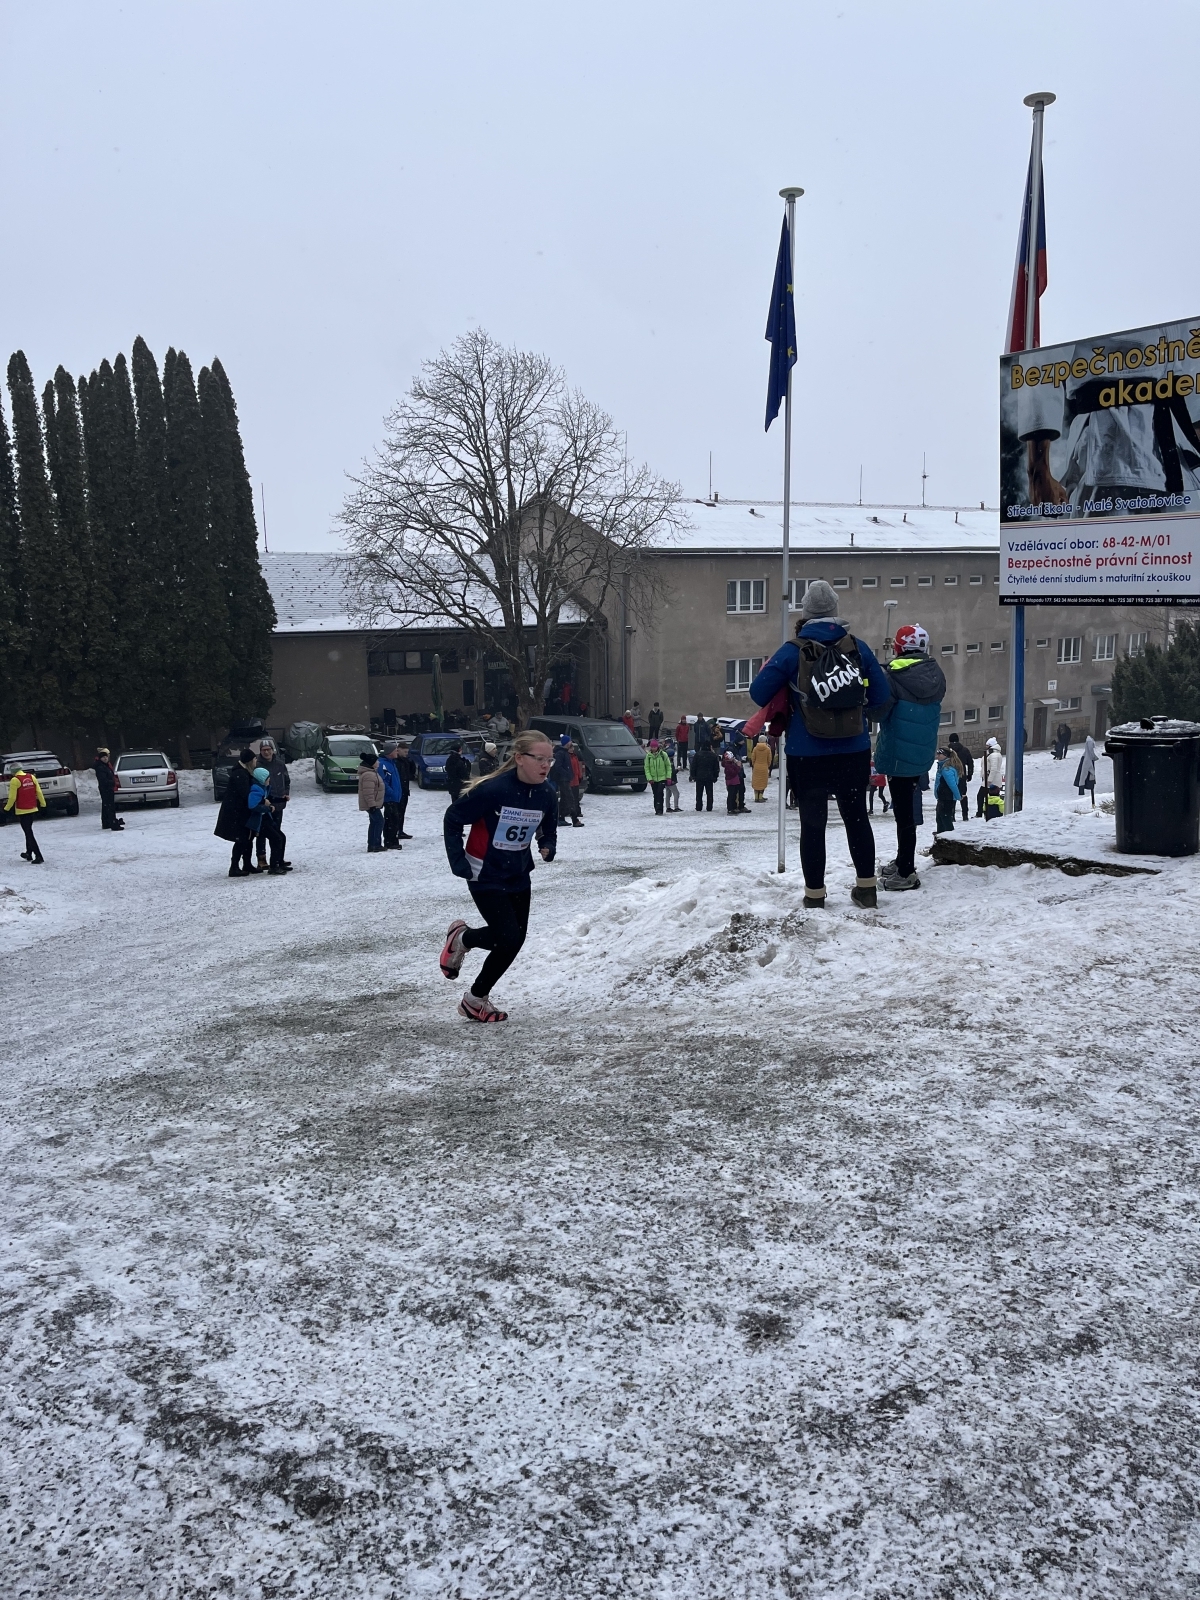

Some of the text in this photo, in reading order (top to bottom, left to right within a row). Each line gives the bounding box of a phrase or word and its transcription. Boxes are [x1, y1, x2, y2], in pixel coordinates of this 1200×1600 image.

[1099, 371, 1200, 408] akade
[1007, 502, 1043, 517] Střední
[1043, 502, 1073, 515] škola
[1083, 497, 1112, 512] Malé
[1115, 494, 1191, 510] Svatoňovice
[1007, 535, 1171, 551] Vzdělávací obor: 68-42-M/01
[1007, 552, 1193, 570] Bezpečnostně právní činnost
[1007, 574, 1038, 585] Čtyřleté
[1039, 573, 1063, 583] denní
[1064, 574, 1097, 583] studium
[1105, 572, 1145, 583] maturitní
[1146, 572, 1191, 582] zkouškou
[505, 825, 530, 842] 65
